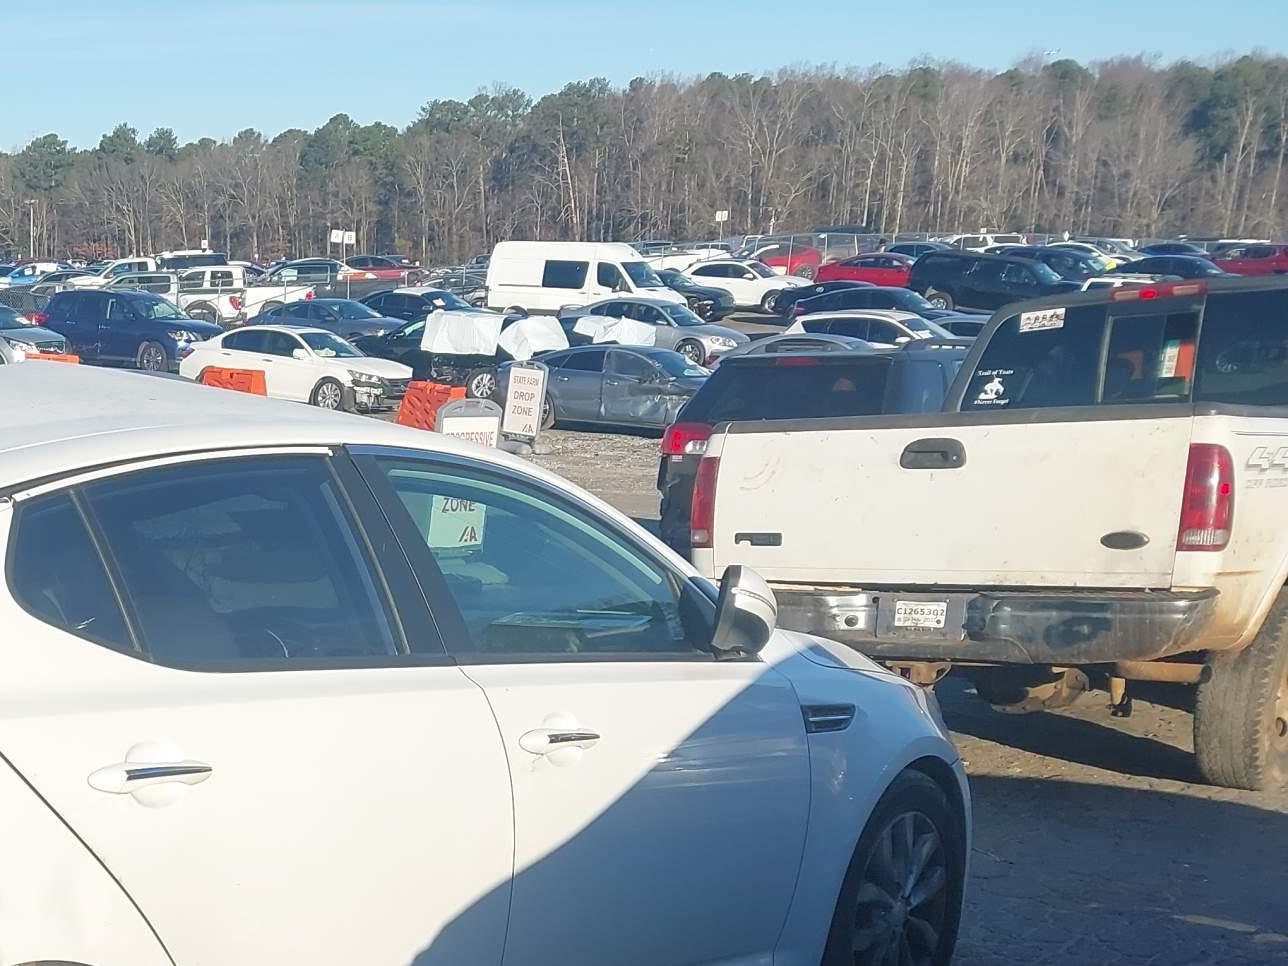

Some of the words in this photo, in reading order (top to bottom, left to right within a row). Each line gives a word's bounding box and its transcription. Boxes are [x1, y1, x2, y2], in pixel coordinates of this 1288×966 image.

[513, 390, 536, 402] DROP
[512, 405, 533, 417] ZONE
[442, 497, 476, 513] ZONE
